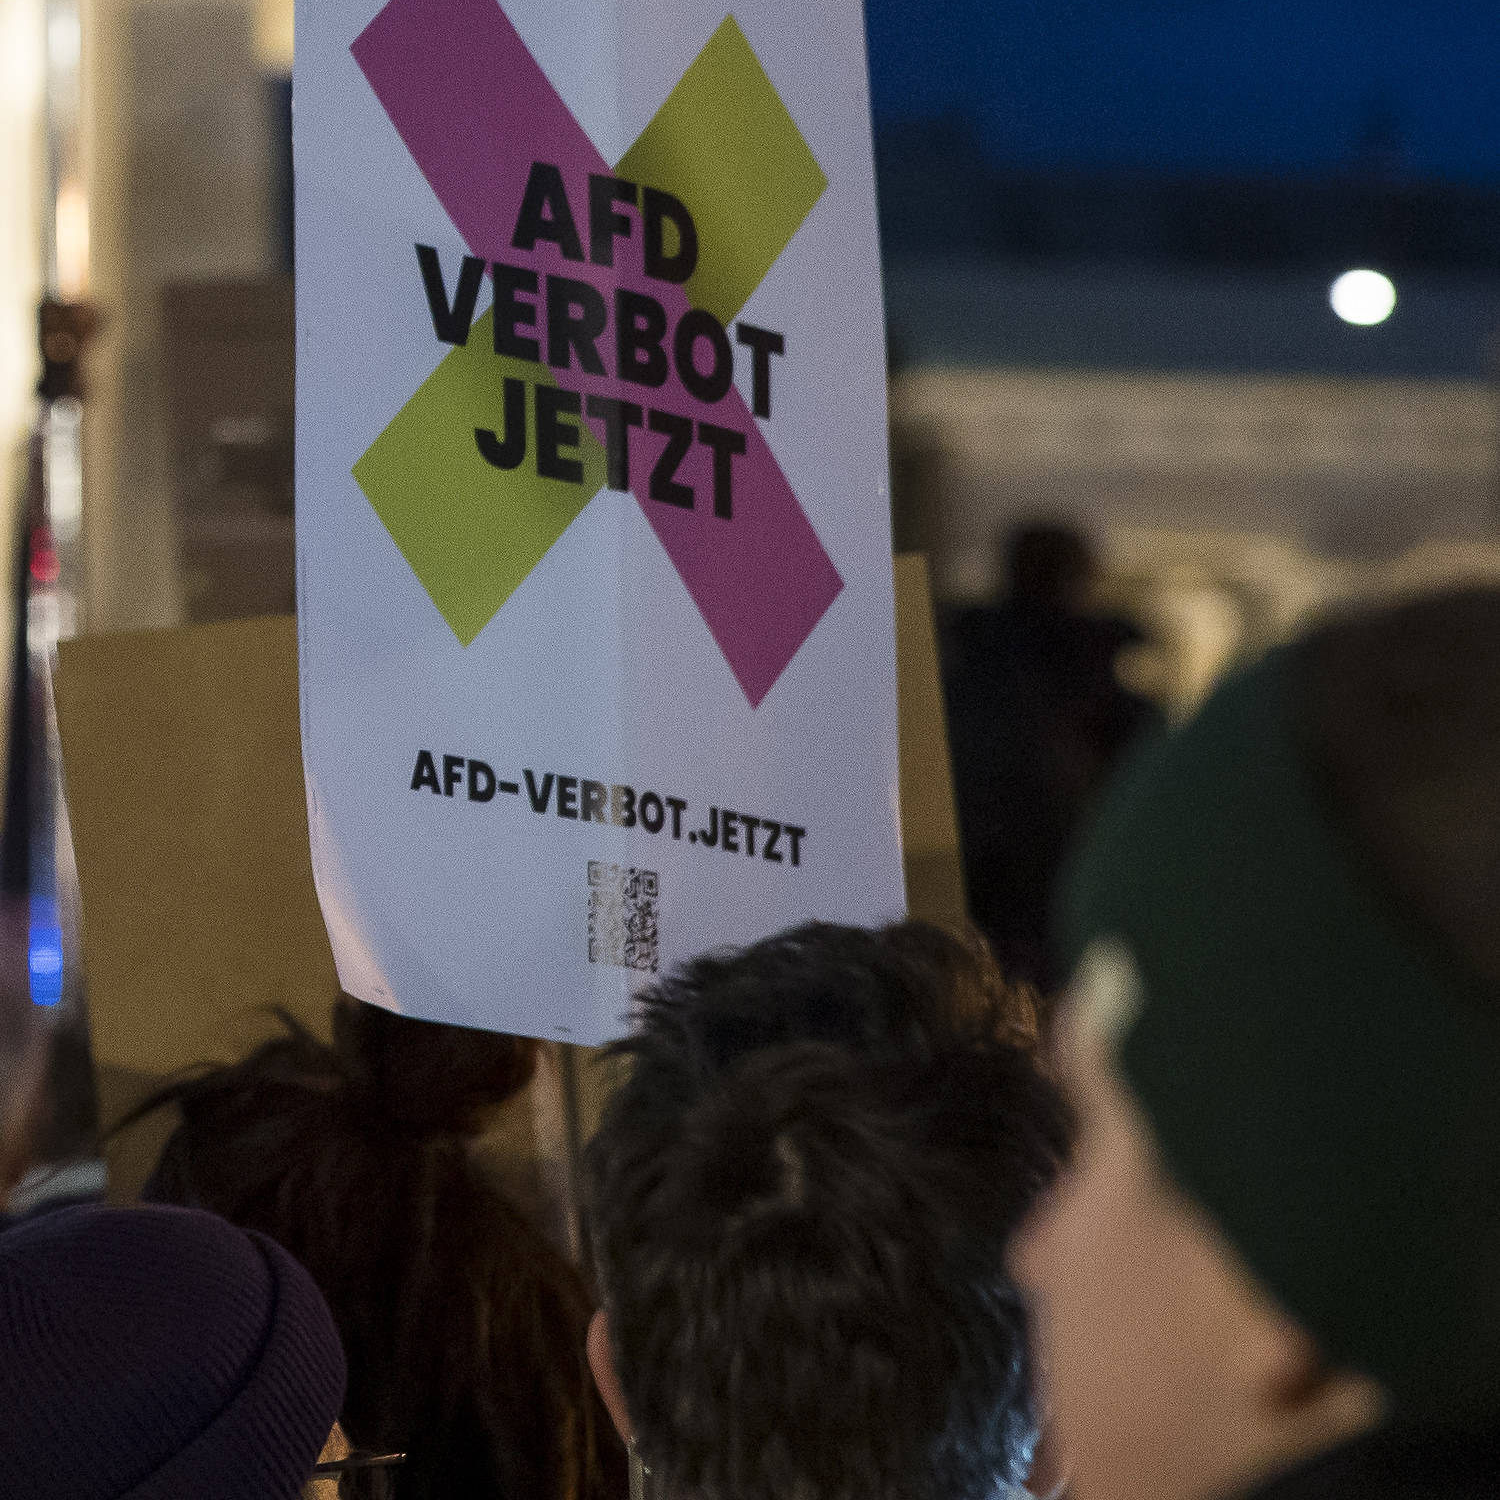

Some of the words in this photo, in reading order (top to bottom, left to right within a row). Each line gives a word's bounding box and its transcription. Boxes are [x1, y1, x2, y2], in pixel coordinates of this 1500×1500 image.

[510, 160, 699, 288] AFD
[415, 243, 785, 422] VERBOT
[473, 376, 750, 523] JETZT
[409, 749, 807, 868] AFD-VERBOT.JETZT
